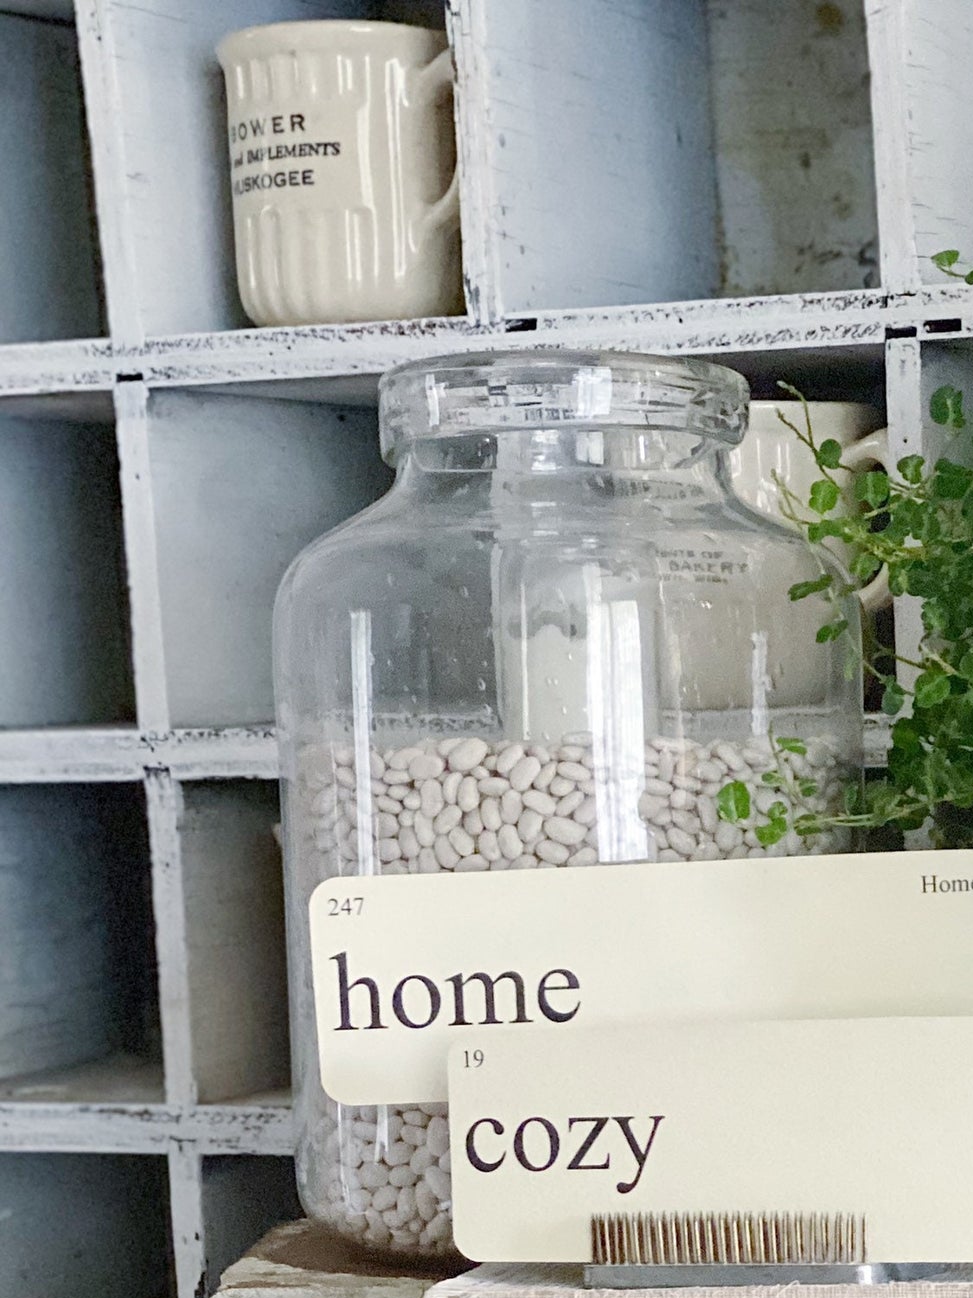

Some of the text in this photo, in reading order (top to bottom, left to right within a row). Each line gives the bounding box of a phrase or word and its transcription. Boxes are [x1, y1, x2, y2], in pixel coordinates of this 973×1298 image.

[327, 897, 365, 916] 247
[328, 951, 582, 1031] home
[463, 1049, 485, 1069] 19
[464, 1114, 666, 1195] cozy
